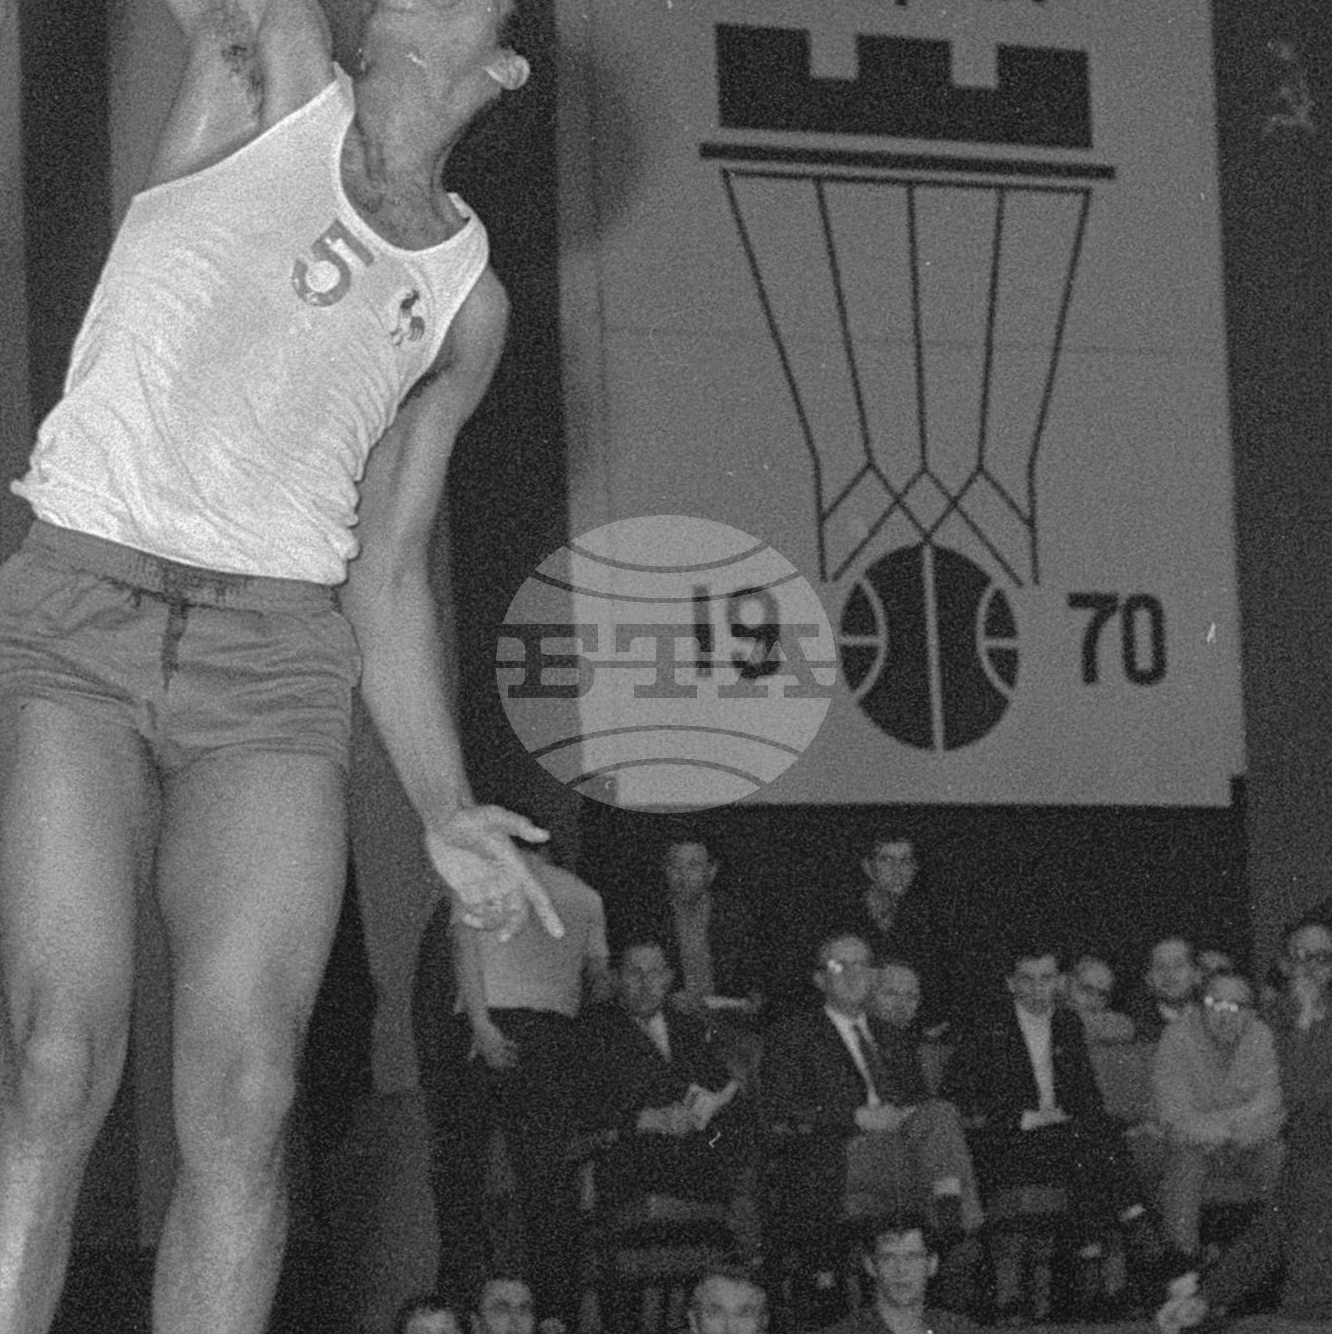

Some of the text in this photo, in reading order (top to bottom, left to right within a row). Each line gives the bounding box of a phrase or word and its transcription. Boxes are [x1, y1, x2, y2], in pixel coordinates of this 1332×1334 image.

[291, 218, 375, 308] 5
[691, 583, 1168, 686] 19 70
